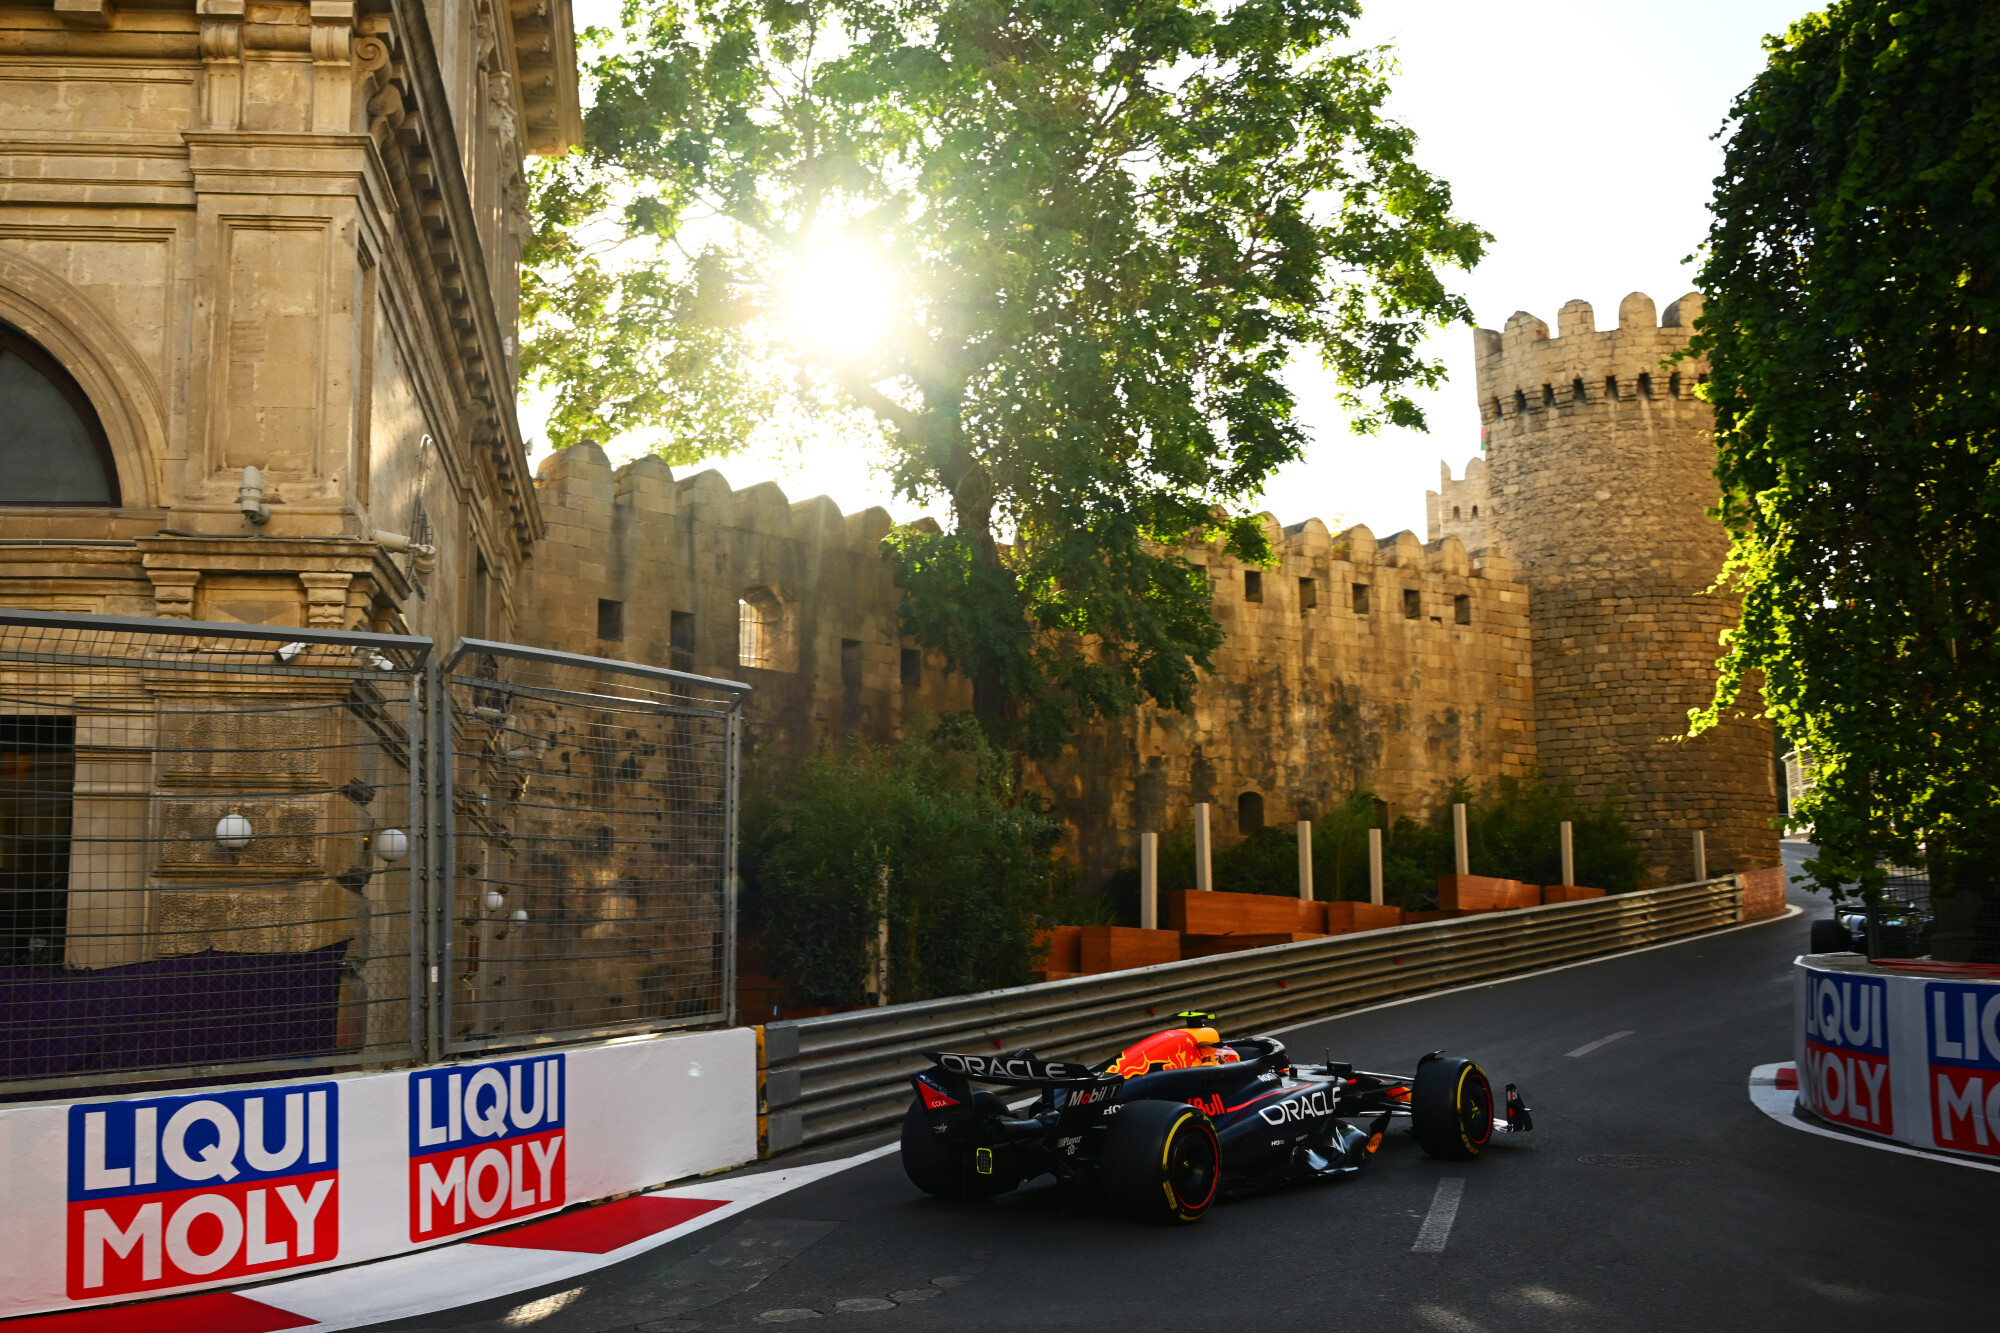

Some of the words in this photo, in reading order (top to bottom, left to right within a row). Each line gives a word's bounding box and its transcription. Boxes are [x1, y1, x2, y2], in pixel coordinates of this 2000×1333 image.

[1807, 975, 1882, 1048] LIQUI
[418, 1059, 559, 1147] LIQUI
[931, 1100, 948, 1108] COLA
[940, 1054, 1067, 1079] ORACLE
[1068, 1086, 1108, 1107] Mobil
[1807, 1047, 1888, 1125] MOLY
[84, 1090, 327, 1190] LIQUI
[418, 1135, 563, 1233] MOLY
[83, 1179, 336, 1289] MOLY
